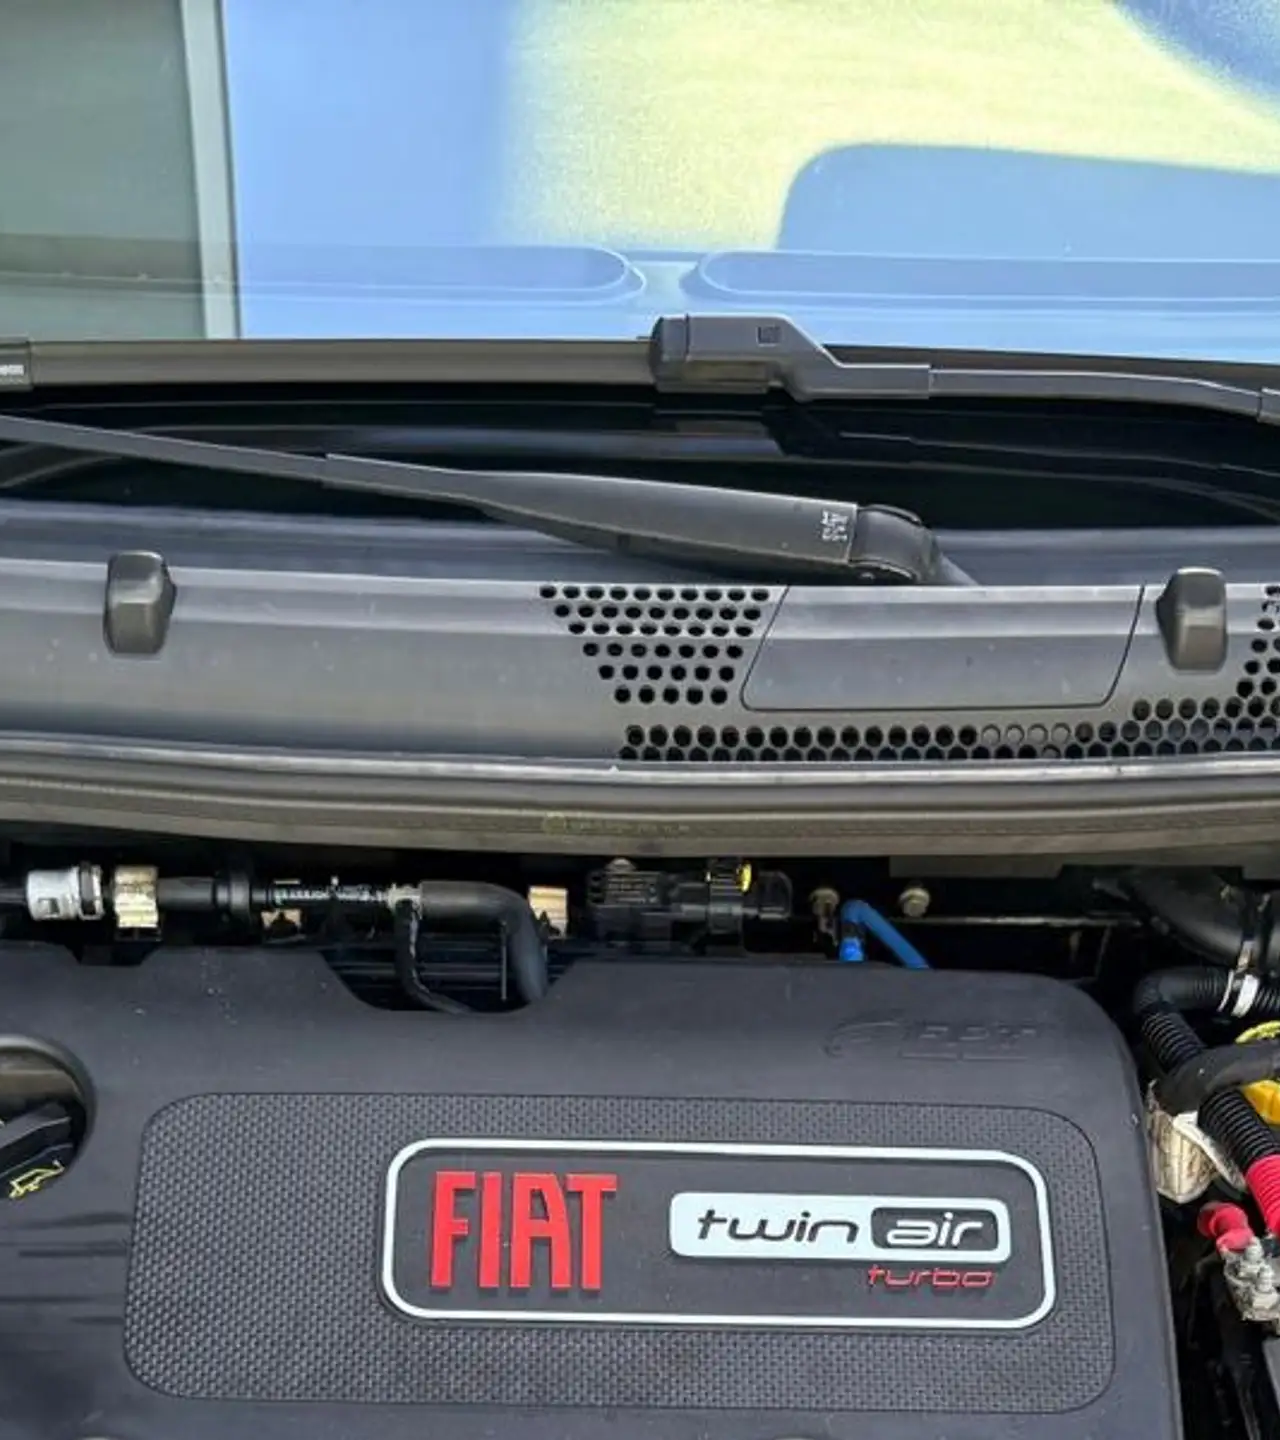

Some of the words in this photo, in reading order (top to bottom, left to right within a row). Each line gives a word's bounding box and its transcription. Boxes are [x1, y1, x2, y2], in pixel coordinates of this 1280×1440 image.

[430, 1170, 618, 1291] FIAT
[697, 1208, 860, 1245] twin
[885, 1212, 984, 1249] air
[866, 1264, 996, 1291] turbo
